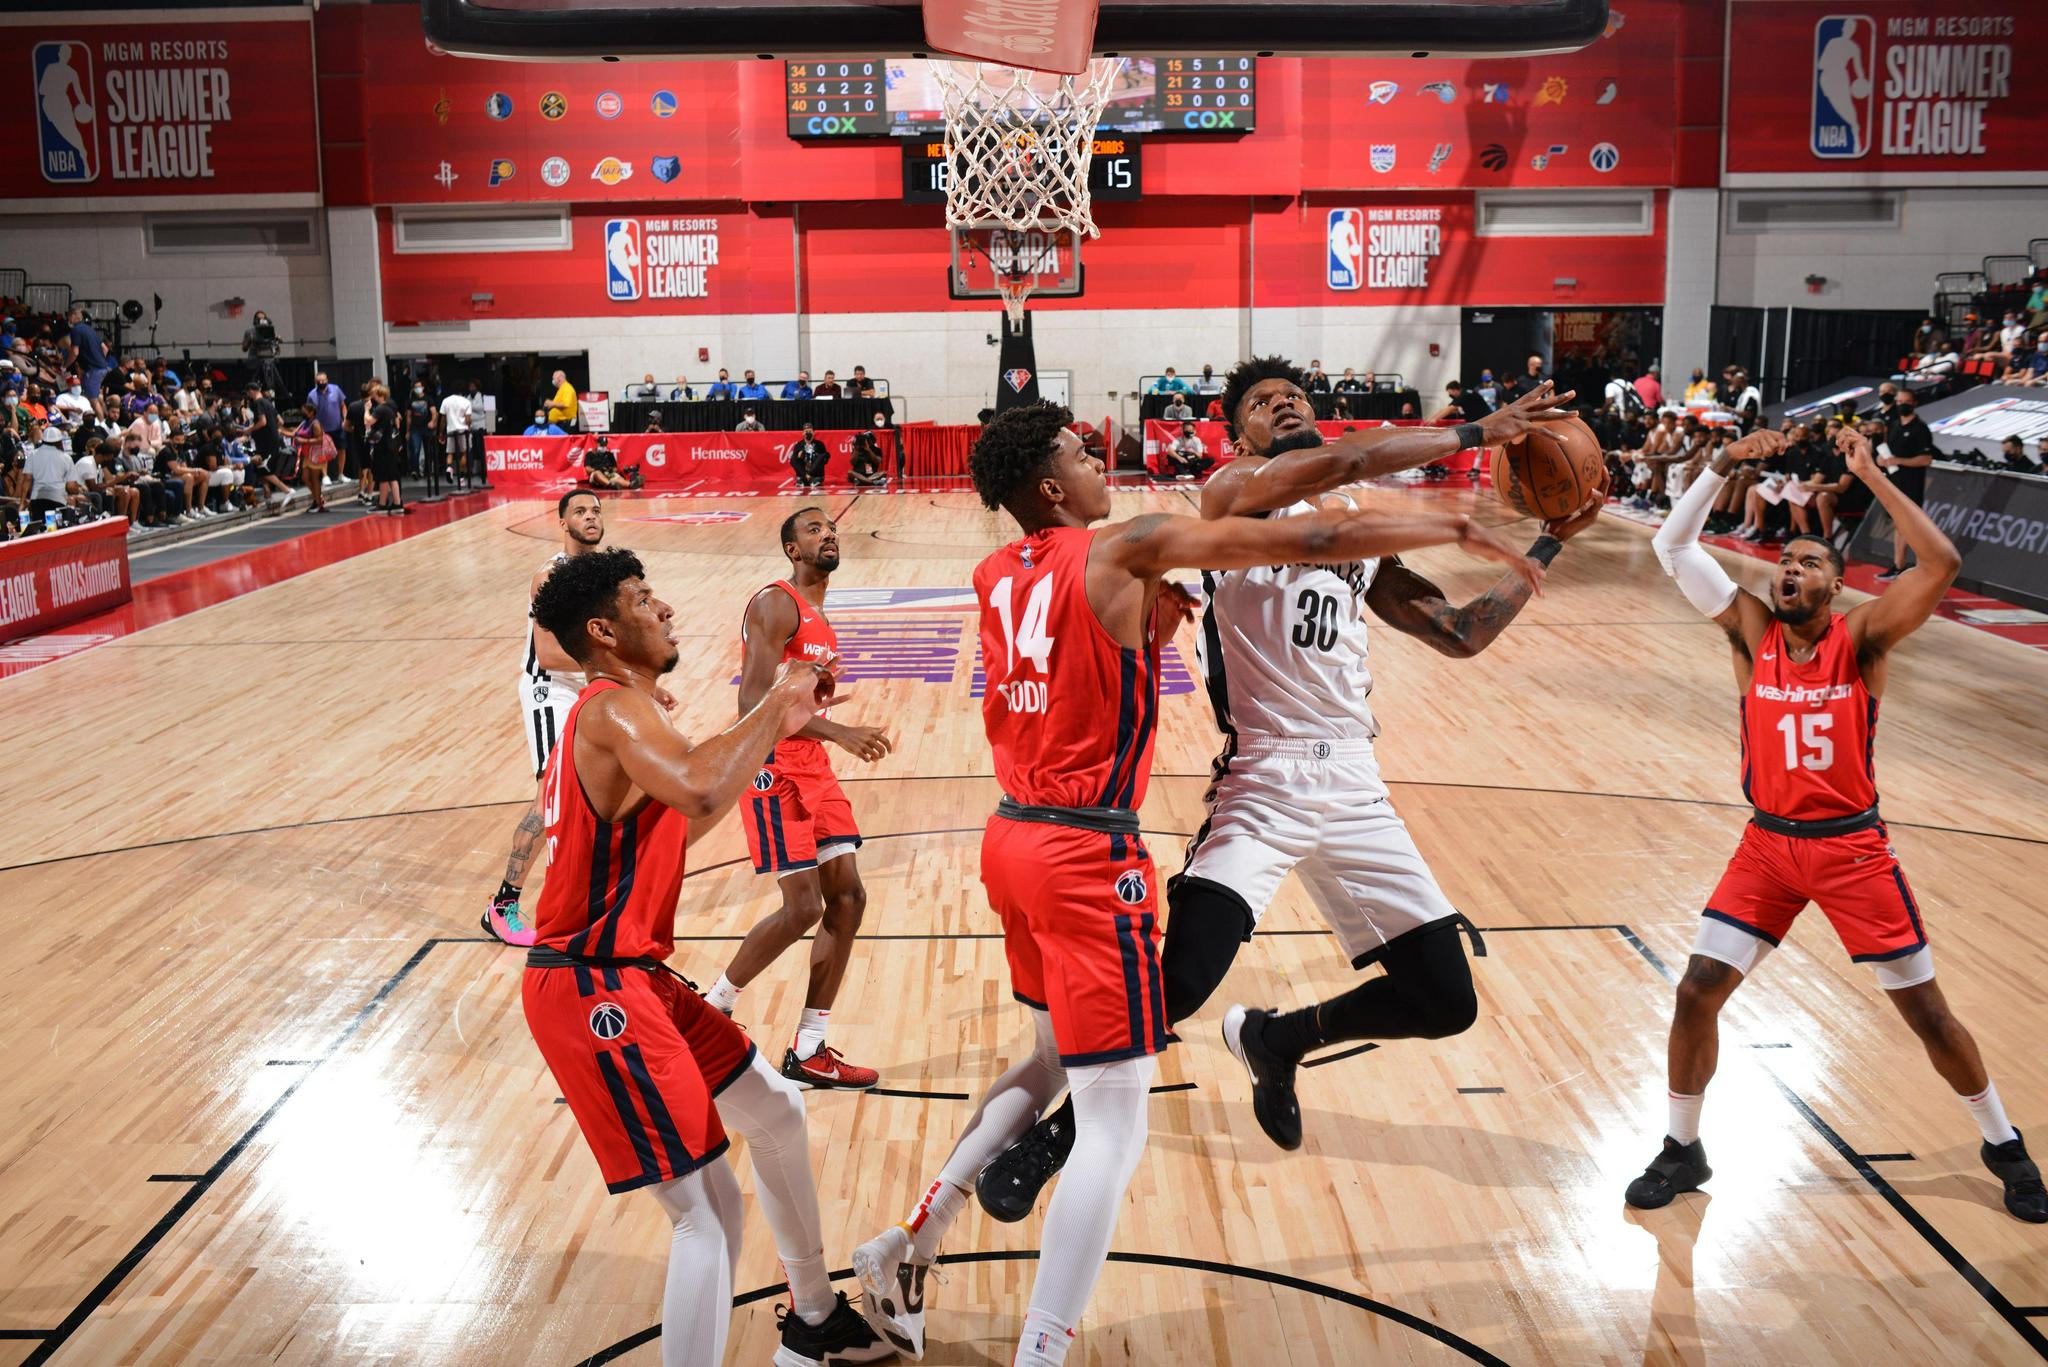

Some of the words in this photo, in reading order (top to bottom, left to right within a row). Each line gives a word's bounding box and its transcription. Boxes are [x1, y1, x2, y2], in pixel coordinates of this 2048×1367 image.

[1887, 18, 1929, 37] MGM
[1935, 16, 2015, 36] RESORTS
[103, 42, 144, 61] MGM
[151, 41, 228, 60] RESORTS
[791, 66, 806, 77] 34
[817, 64, 826, 77] 0
[840, 64, 849, 77] 0
[863, 63, 873, 76] 0
[1167, 59, 1183, 72] 15
[1193, 59, 1202, 71] 5
[1218, 59, 1225, 71] 1
[1239, 58, 1249, 71] 0
[1884, 45, 2012, 99] SUMMER
[791, 82, 807, 94] 35
[817, 83, 826, 95] 4
[840, 82, 849, 95] 2
[864, 82, 873, 95] 2
[1167, 76, 1183, 89] 21
[1192, 77, 1202, 89] 2
[1215, 76, 1225, 89] 0
[1239, 76, 1249, 89] 0
[106, 68, 231, 123] SUMMER
[791, 99, 807, 111] 40
[817, 100, 827, 113] 0
[843, 101, 850, 113] 1
[864, 99, 874, 112] 0
[1167, 94, 1183, 106] 33
[1193, 94, 1202, 107] 0
[1216, 94, 1226, 107] 0
[1240, 94, 1250, 106] 0
[807, 116, 857, 135] COX
[1184, 111, 1235, 129] COX
[1881, 101, 1988, 155] LEAGUE
[1818, 125, 1848, 147] NBA
[49, 151, 77, 172] NBA
[109, 125, 215, 178] LEAGUE
[1107, 159, 1132, 188] 15
[645, 220, 669, 232] MGM
[672, 219, 718, 231] RESORTS
[1368, 209, 1393, 221] MGM
[1395, 209, 1441, 221] RESORTS
[646, 234, 719, 266] SUMMER
[1368, 224, 1440, 256] SUMMER
[648, 266, 708, 298] LEAGUE
[1368, 256, 1428, 288] LEAGUE
[611, 281, 629, 294] NBA
[506, 448, 544, 462] MGM
[691, 446, 748, 462] Hennessy
[507, 462, 544, 470] RESORTS
[49, 558, 121, 609] #NBASummer
[989, 571, 1055, 676] 14
[1292, 589, 1338, 652] 30
[1756, 684, 1852, 708] washington
[1777, 713, 1834, 771] 15
